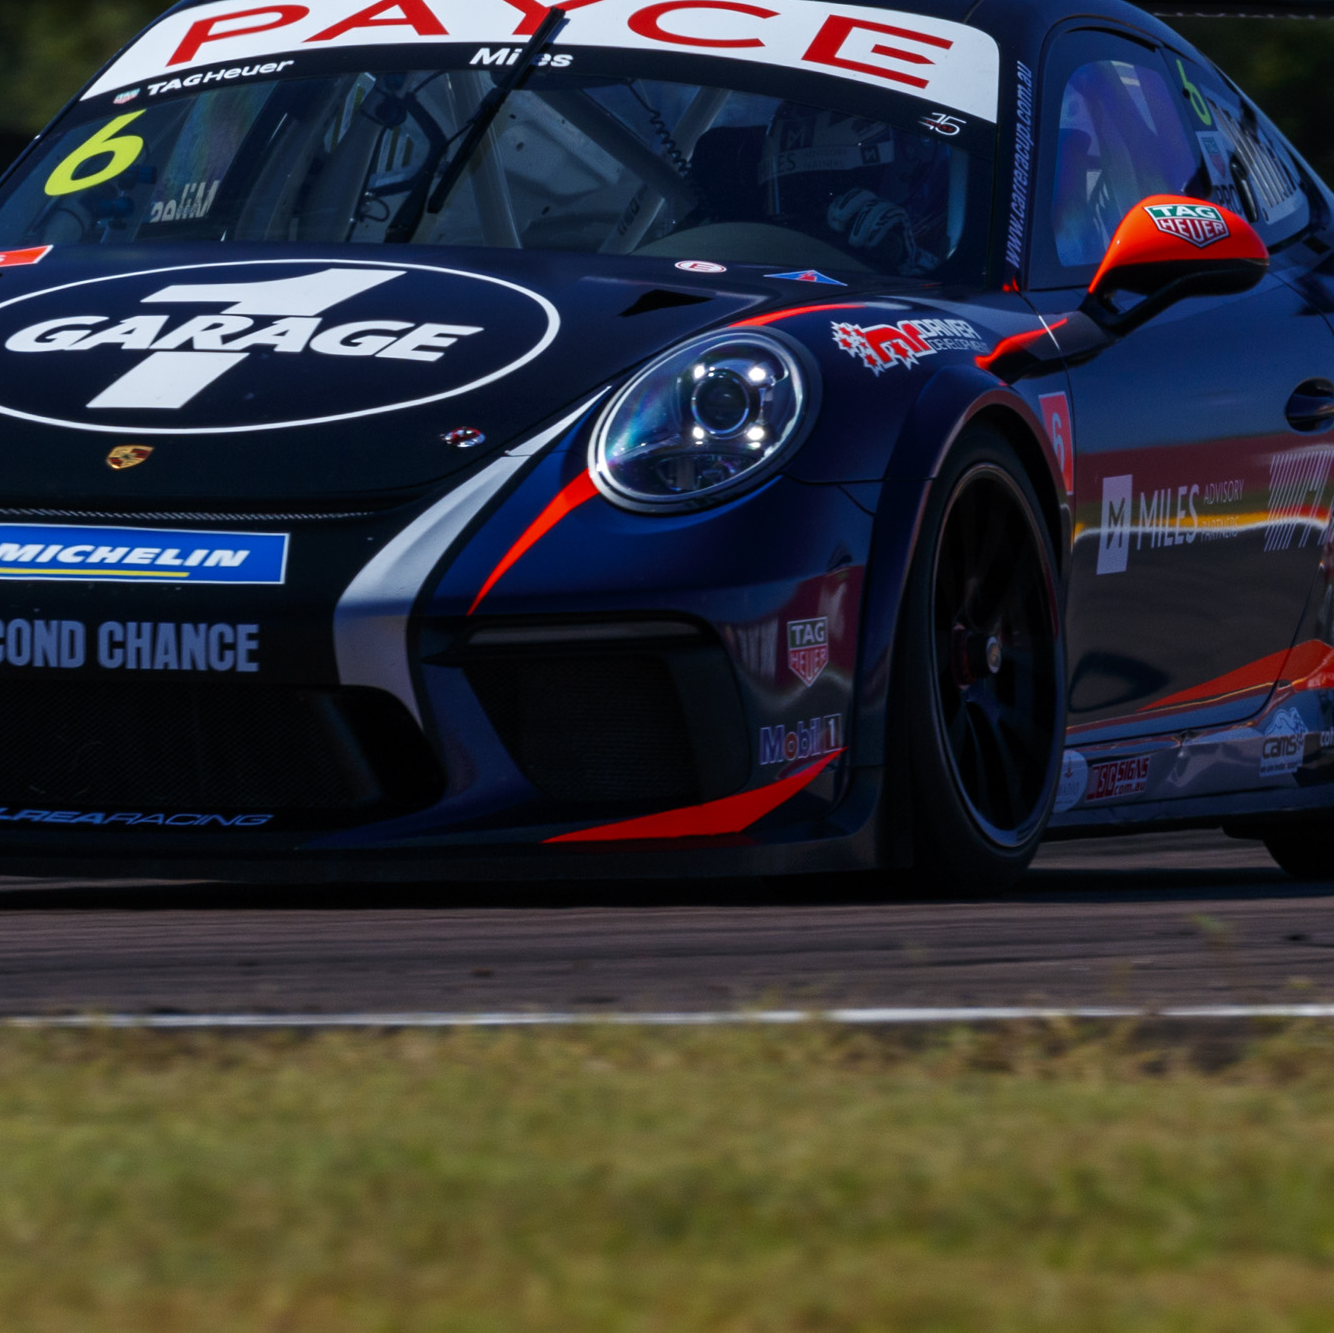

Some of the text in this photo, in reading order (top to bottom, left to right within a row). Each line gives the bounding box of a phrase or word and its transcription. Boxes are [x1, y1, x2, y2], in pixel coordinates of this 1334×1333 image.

[469, 47, 574, 68] Mies
[1176, 59, 1212, 126] 6
[44, 109, 146, 197] 6
[1005, 60, 1034, 270] www.carreracup.com.au
[1158, 205, 1219, 220] TAG
[1161, 218, 1227, 242] HEUER
[5, 314, 485, 362] GARAGE
[918, 318, 982, 340] DRIVER
[1203, 478, 1245, 505] ADVISORY
[1136, 483, 1201, 551] MILES
[98, 620, 260, 672] CHANCE
[792, 622, 826, 645] TAG
[790, 648, 827, 681] HEUER
[760, 718, 821, 765] Mobil
